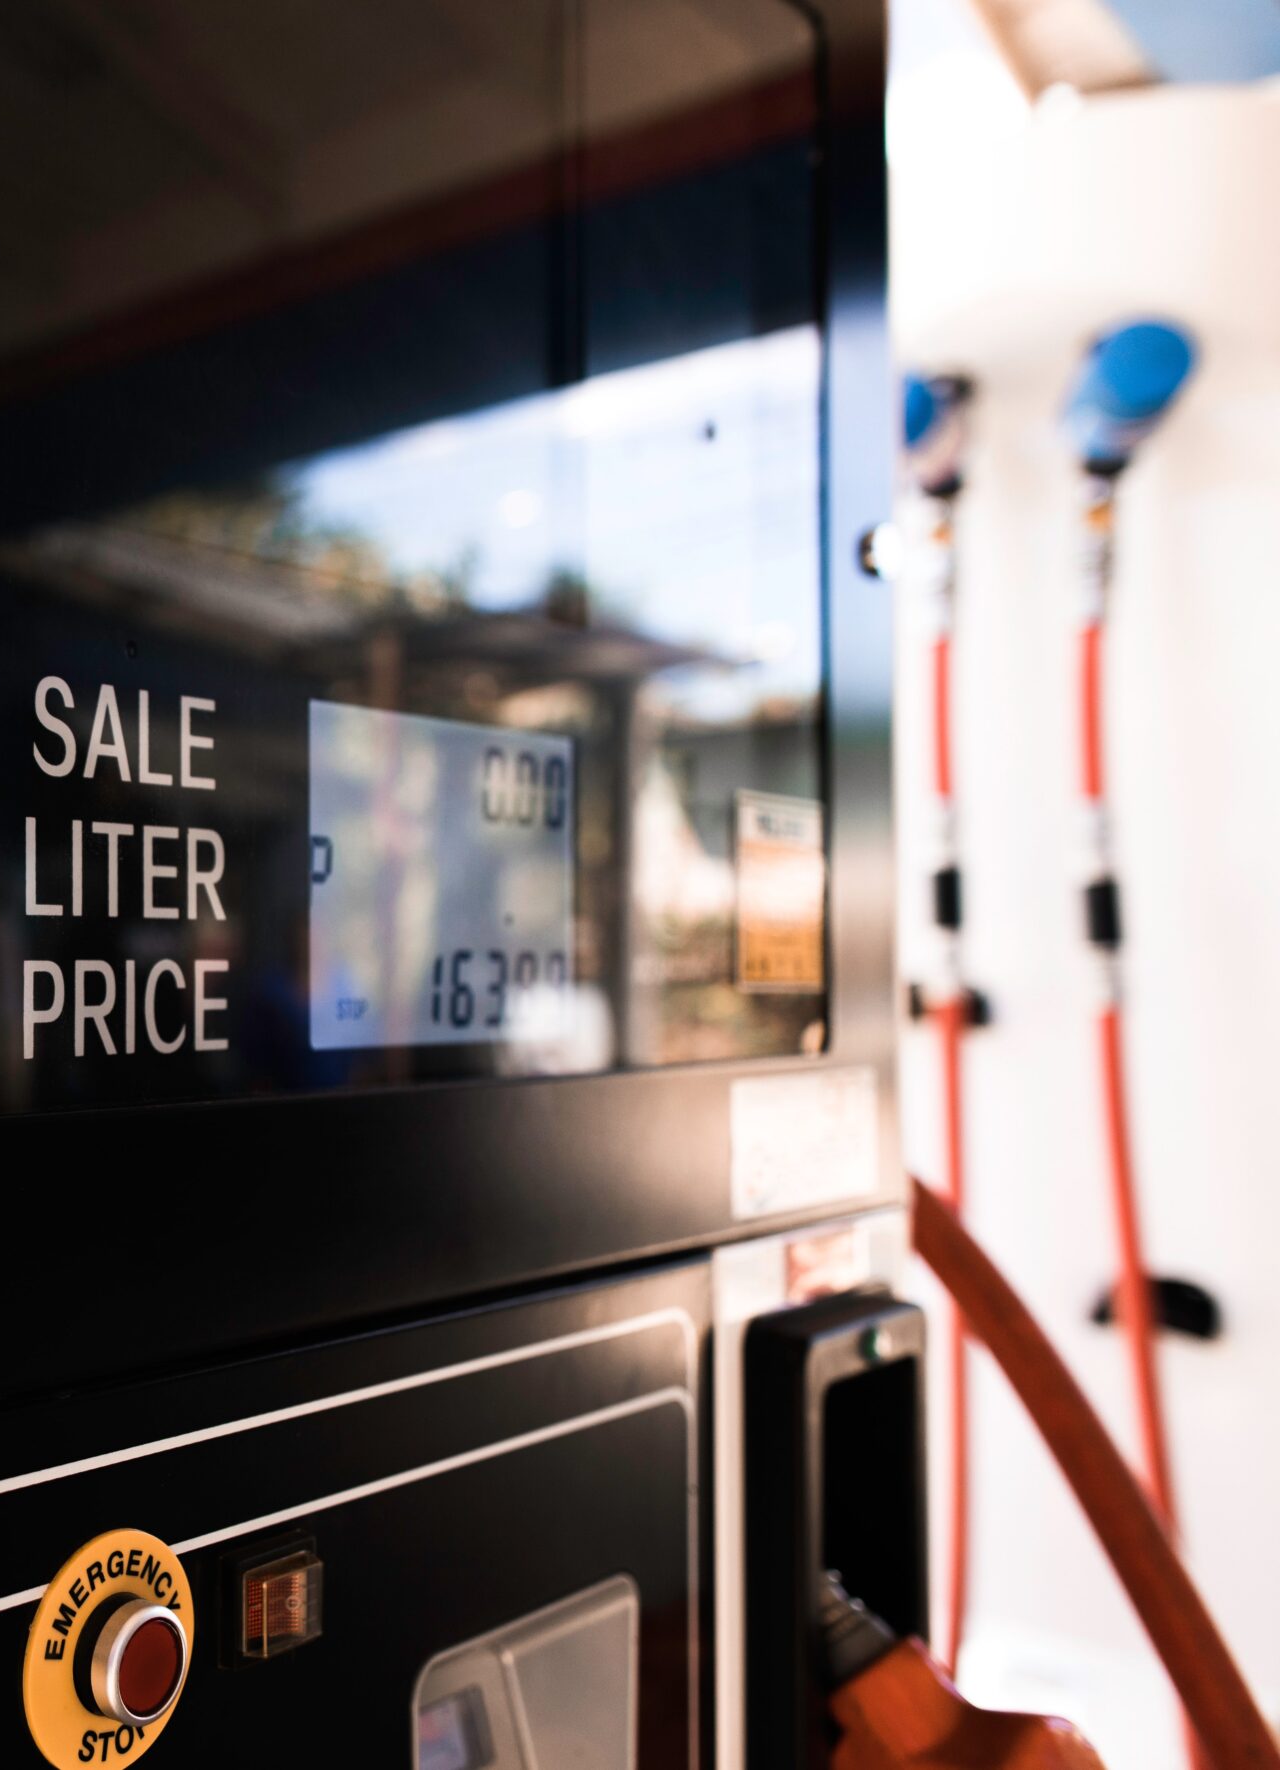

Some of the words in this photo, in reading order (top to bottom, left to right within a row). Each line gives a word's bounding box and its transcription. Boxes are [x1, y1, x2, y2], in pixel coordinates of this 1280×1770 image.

[32, 674, 217, 791] SALE
[24, 815, 227, 921] LITER
[22, 958, 230, 1060] PRICE
[44, 1549, 181, 1661] EMERGENCY
